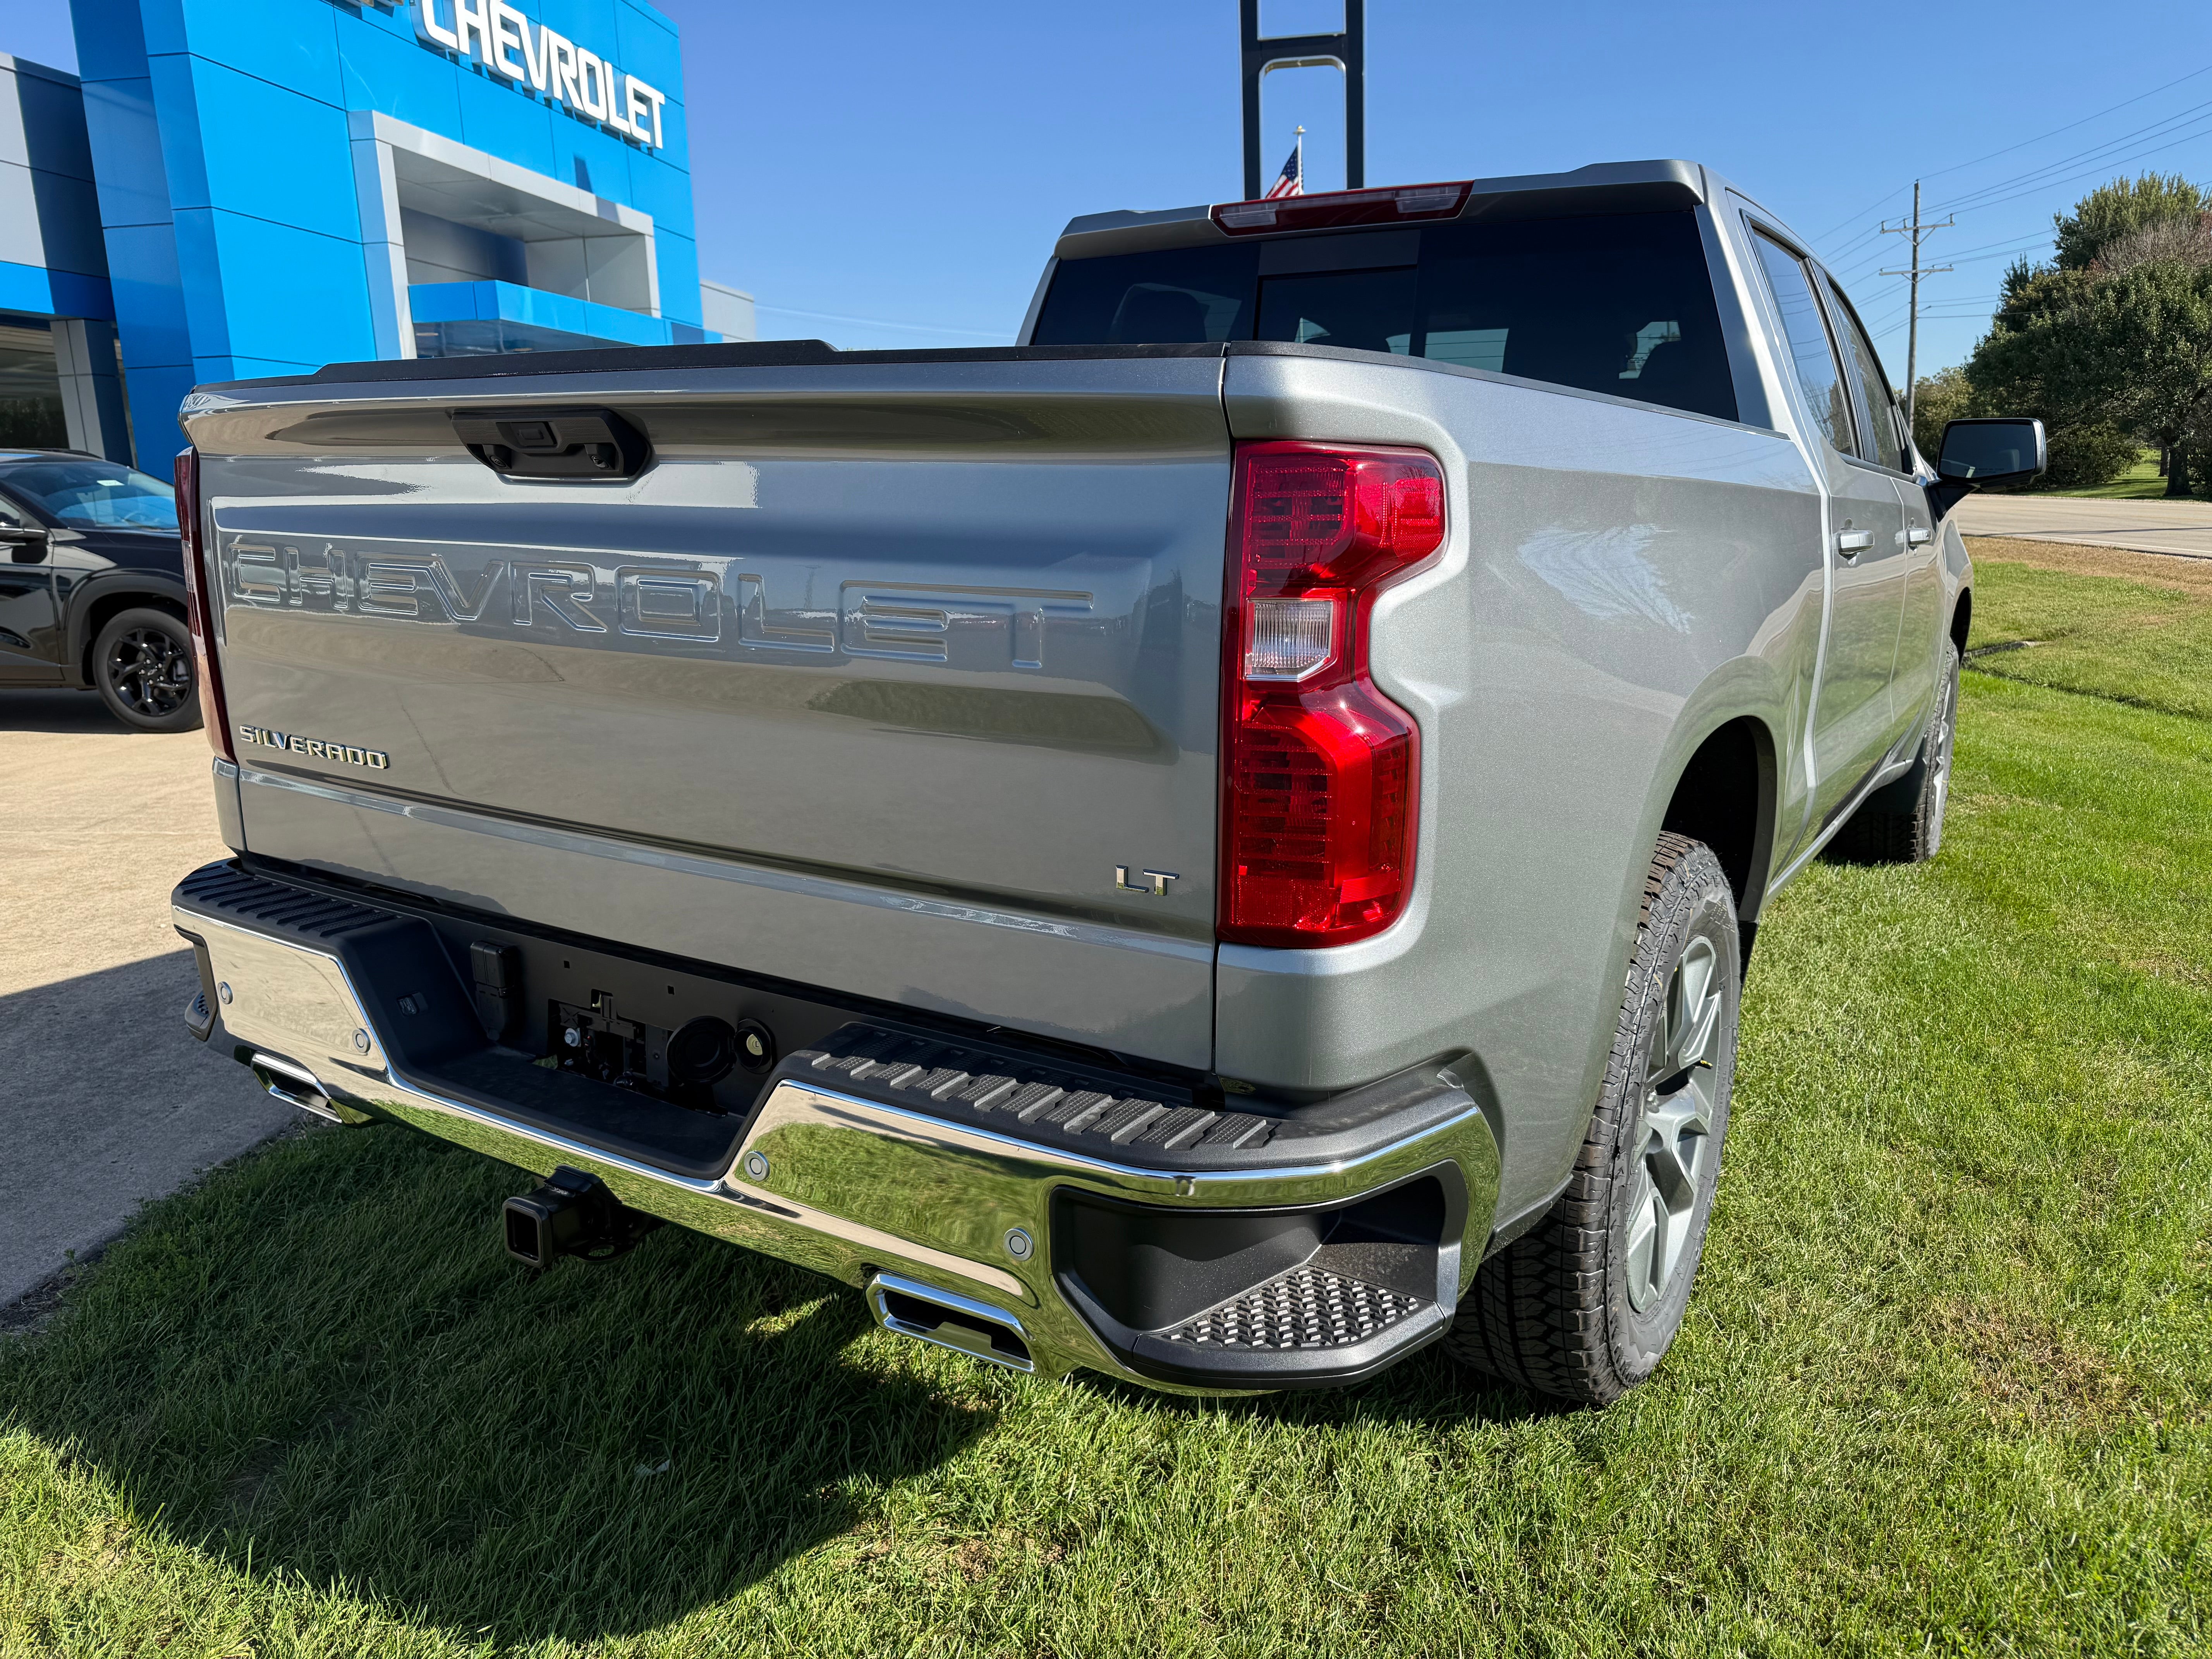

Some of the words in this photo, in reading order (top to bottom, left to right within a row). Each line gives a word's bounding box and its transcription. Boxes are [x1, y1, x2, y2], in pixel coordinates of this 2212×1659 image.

[228, 542, 1094, 668] CHEVROLET
[239, 724, 390, 769] SILVERADO
[1115, 864, 1180, 896] LT
